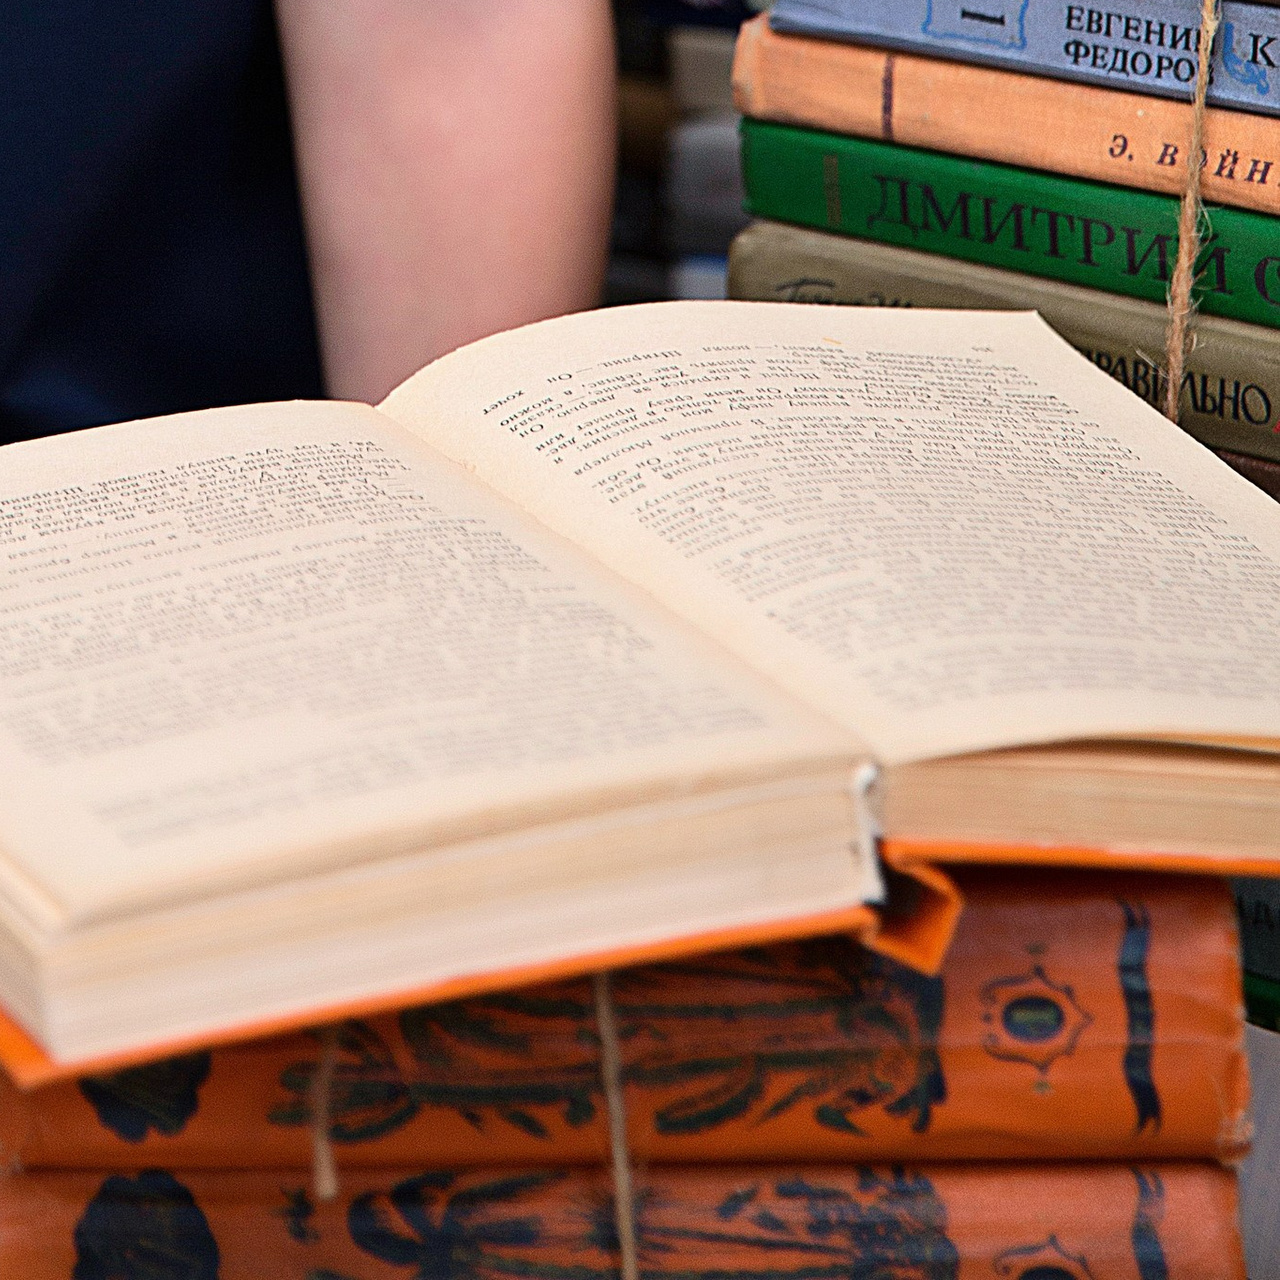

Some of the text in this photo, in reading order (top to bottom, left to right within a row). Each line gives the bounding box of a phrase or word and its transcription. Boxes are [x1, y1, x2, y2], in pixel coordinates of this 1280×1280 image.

[867, 174, 1232, 295] ДМИТРИЙ
[656, 365, 680, 374] вас
[547, 373, 573, 384] Он
[581, 372, 643, 388] сейчас,
[588, 370, 689, 396] усмотрение,
[660, 375, 731, 389] скрылся
[704, 389, 745, 398] меня
[1085, 351, 1270, 425] РАВИЛЬНО
[483, 390, 524, 415] хочет
[556, 393, 616, 418] дверью.
[648, 395, 693, 409] сразу
[663, 399, 722, 413] только
[728, 402, 774, 411] шефу
[499, 397, 553, 427] можно
[509, 403, 563, 433] сказал
[576, 407, 635, 431] примет
[681, 408, 713, 418] мои
[519, 423, 544, 438] Он
[583, 414, 638, 437] девять
[660, 420, 743, 442] приемной
[535, 433, 565, 452] или
[546, 436, 576, 456] две-
[673, 437, 743, 456] позиция.
[717, 439, 785, 455] правоту
[237, 448, 347, 466] охранникам.
[245, 448, 283, 457] чуть
[291, 453, 364, 464] Мюллер
[553, 456, 563, 465] я
[573, 439, 653, 476] Мюллера
[175, 455, 237, 471] кивнул
[228, 461, 281, 475] вынул
[319, 465, 364, 473] было
[635, 457, 662, 469] Он
[651, 457, 690, 473] этом
[661, 452, 760, 480] следующий
[92, 469, 166, 489] головой.
[149, 463, 232, 485] Штирлиц
[197, 473, 217, 481] из
[198, 474, 248, 489] входа
[316, 470, 389, 481] Мюллер
[597, 469, 628, 487] обя-
[119, 480, 184, 497] заднего
[243, 478, 306, 494] тяжело
[607, 472, 642, 494] деле.
[0, 486, 84, 506] Штирлиц
[12, 482, 141, 511] вопросительно
[134, 491, 166, 503] этот
[609, 483, 647, 504] этап
[35, 495, 110, 514] кармана
[62, 500, 123, 517] подвал
[97, 495, 186, 517] несколько
[146, 492, 234, 515] спустился
[31, 515, 85, 530] камер
[114, 513, 136, 521] по
[38, 519, 105, 537] крутым
